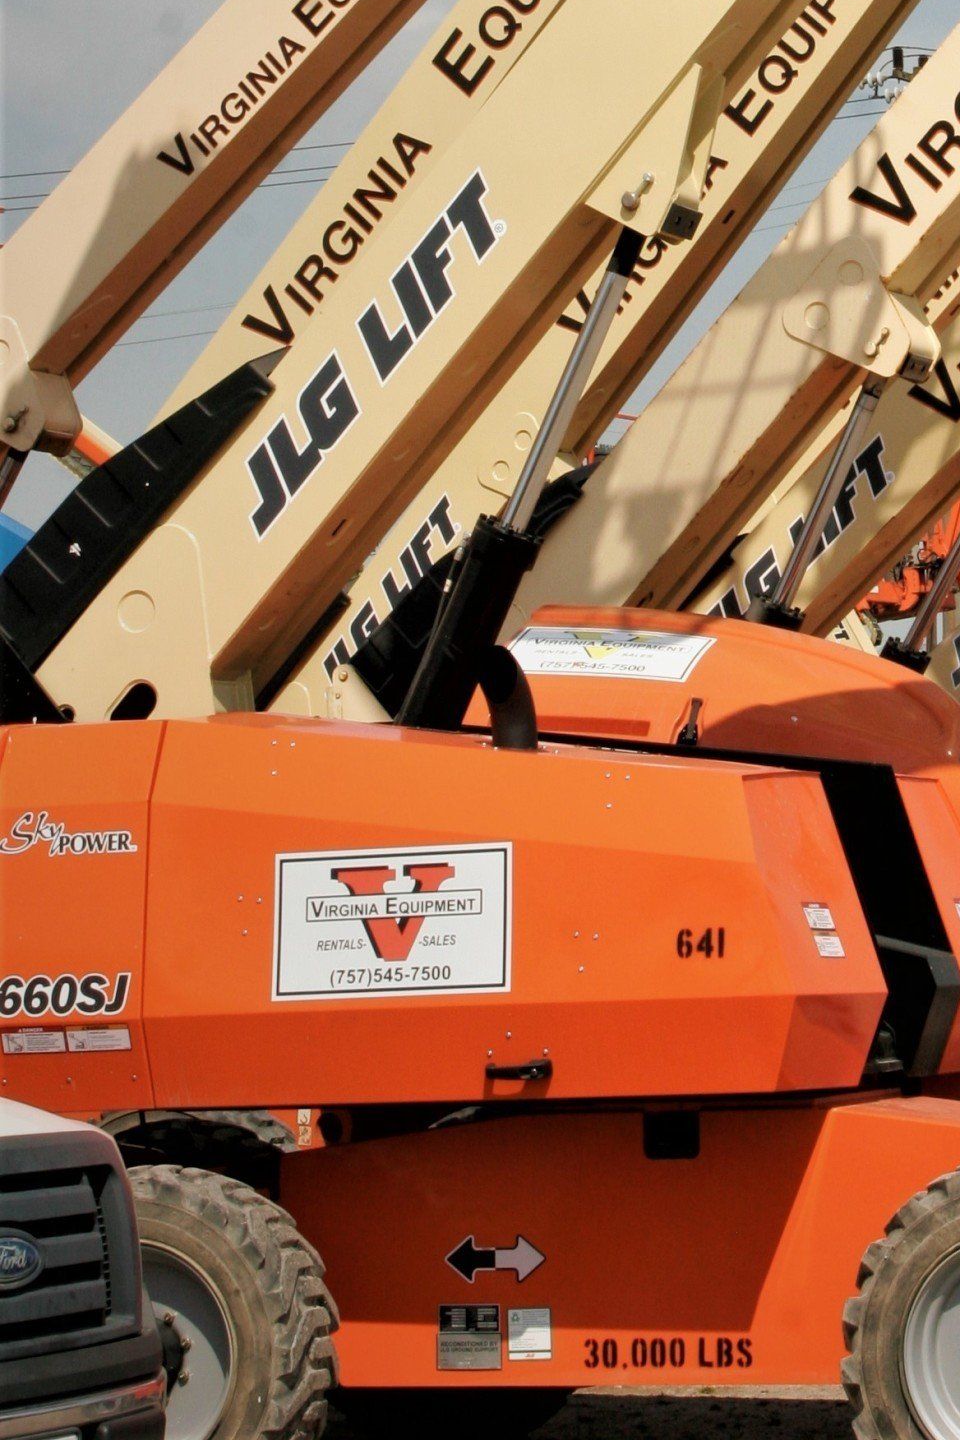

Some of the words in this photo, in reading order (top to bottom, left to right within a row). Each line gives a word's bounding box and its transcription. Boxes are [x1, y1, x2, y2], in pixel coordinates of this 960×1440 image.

[157, 36, 306, 177] VIRGINIA
[241, 132, 432, 347] VIRGINIA
[244, 348, 362, 542] JLG
[355, 167, 492, 388] LIFT
[533, 638, 596, 647] VIRGINIA
[311, 900, 379, 918] VIRGINIA
[386, 897, 476, 915] EQUIPMENT
[677, 927, 725, 959] 641
[330, 965, 451, 987] (757)545-7500
[0, 973, 130, 1016] 660SJ
[699, 1337, 753, 1368] LBS
